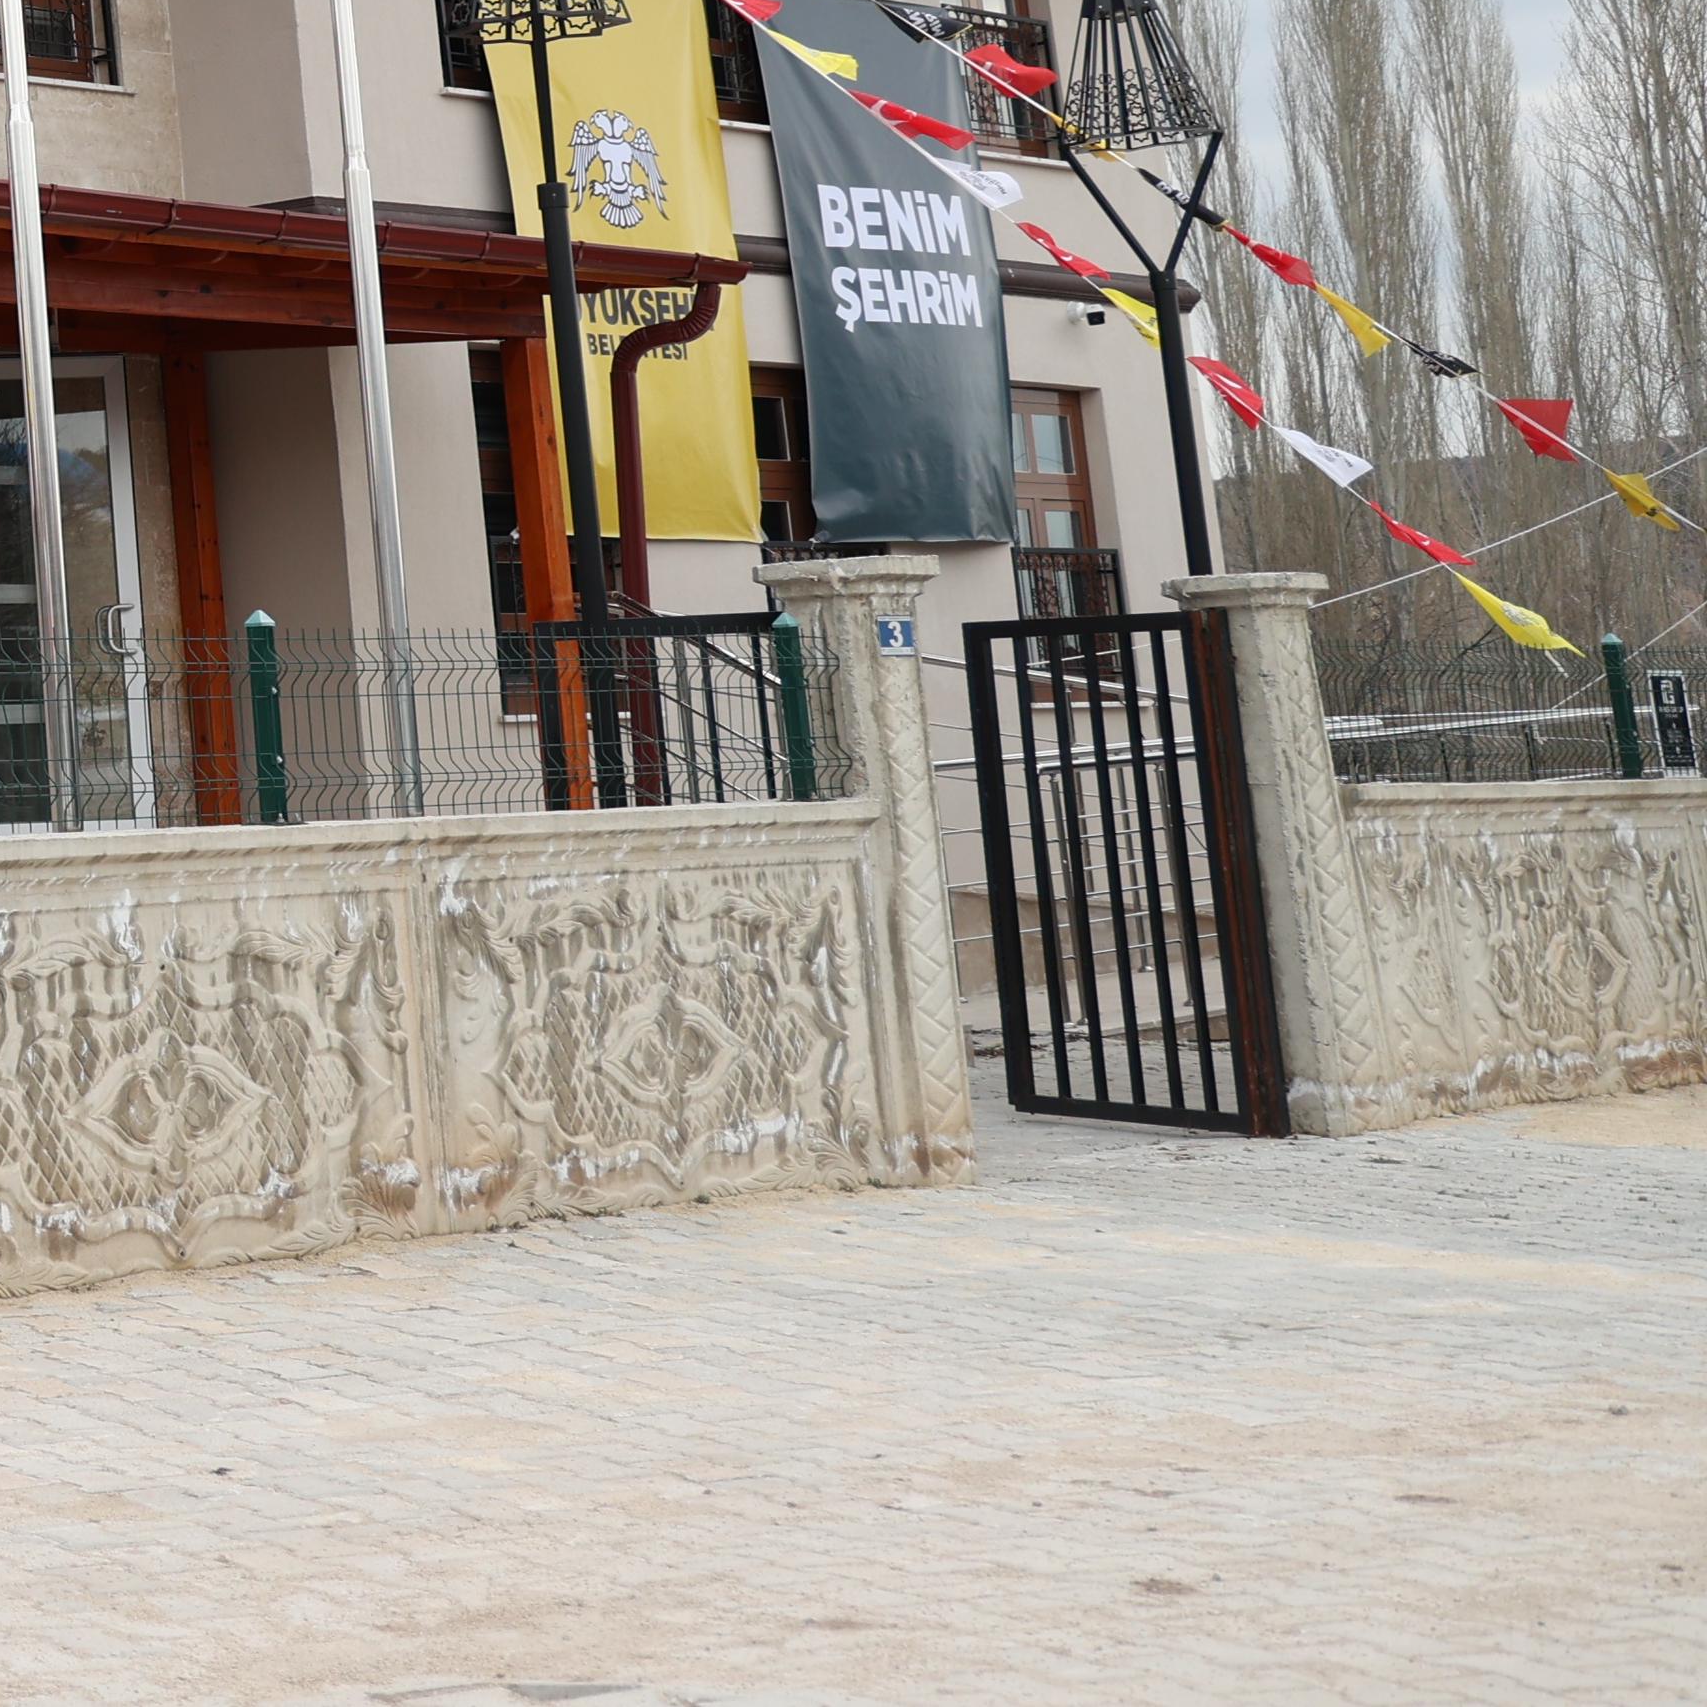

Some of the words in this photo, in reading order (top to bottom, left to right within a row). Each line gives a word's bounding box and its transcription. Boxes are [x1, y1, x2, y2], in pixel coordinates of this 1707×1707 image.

[817, 184, 971, 257] BENİM
[831, 266, 983, 333] ŞEHRİM
[888, 621, 904, 648] 3
